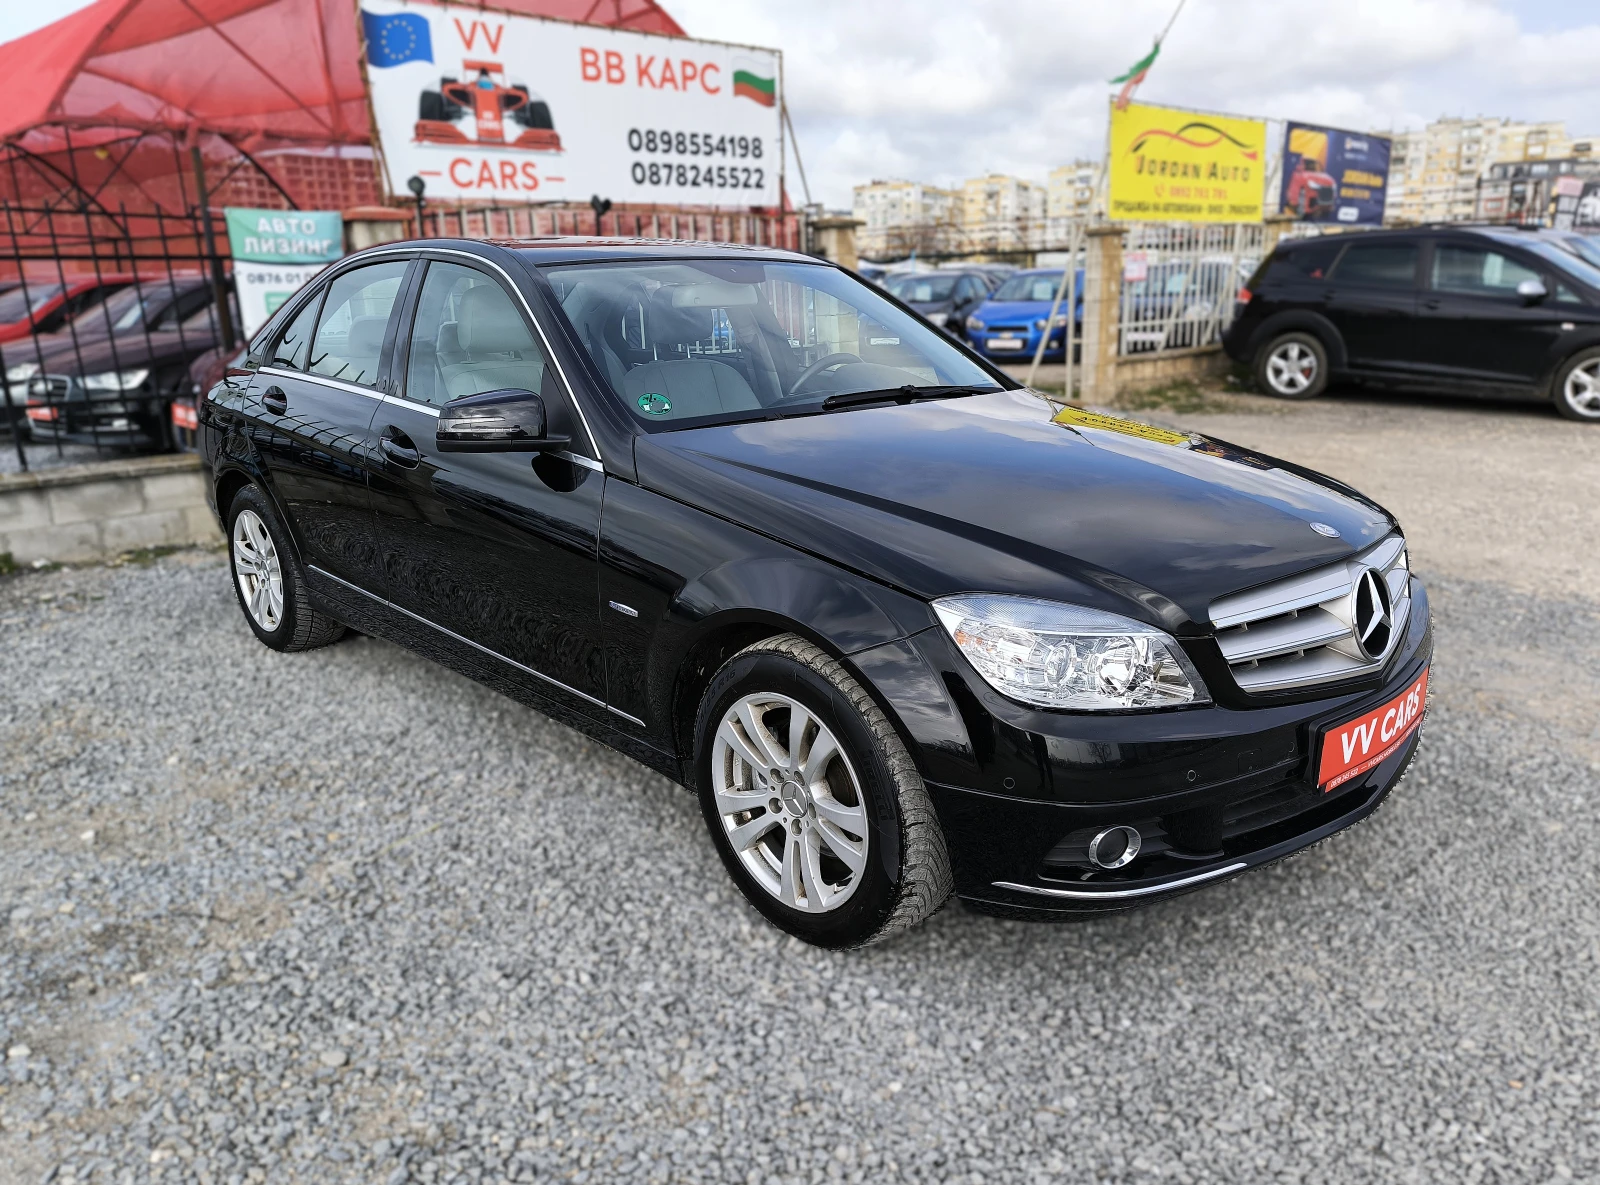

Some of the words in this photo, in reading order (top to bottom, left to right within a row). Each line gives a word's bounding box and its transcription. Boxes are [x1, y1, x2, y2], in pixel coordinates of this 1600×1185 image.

[454, 18, 504, 54] VV
[580, 47, 625, 85] ВВ
[636, 54, 722, 95] КАРС
[628, 128, 763, 158] 0898554198
[449, 157, 540, 191] CARS
[631, 162, 765, 189] 0878245522
[257, 217, 316, 235] АВТО
[244, 237, 333, 256] ЛИЗИНГ
[1341, 717, 1378, 765] VV
[1380, 683, 1422, 743] CARS
